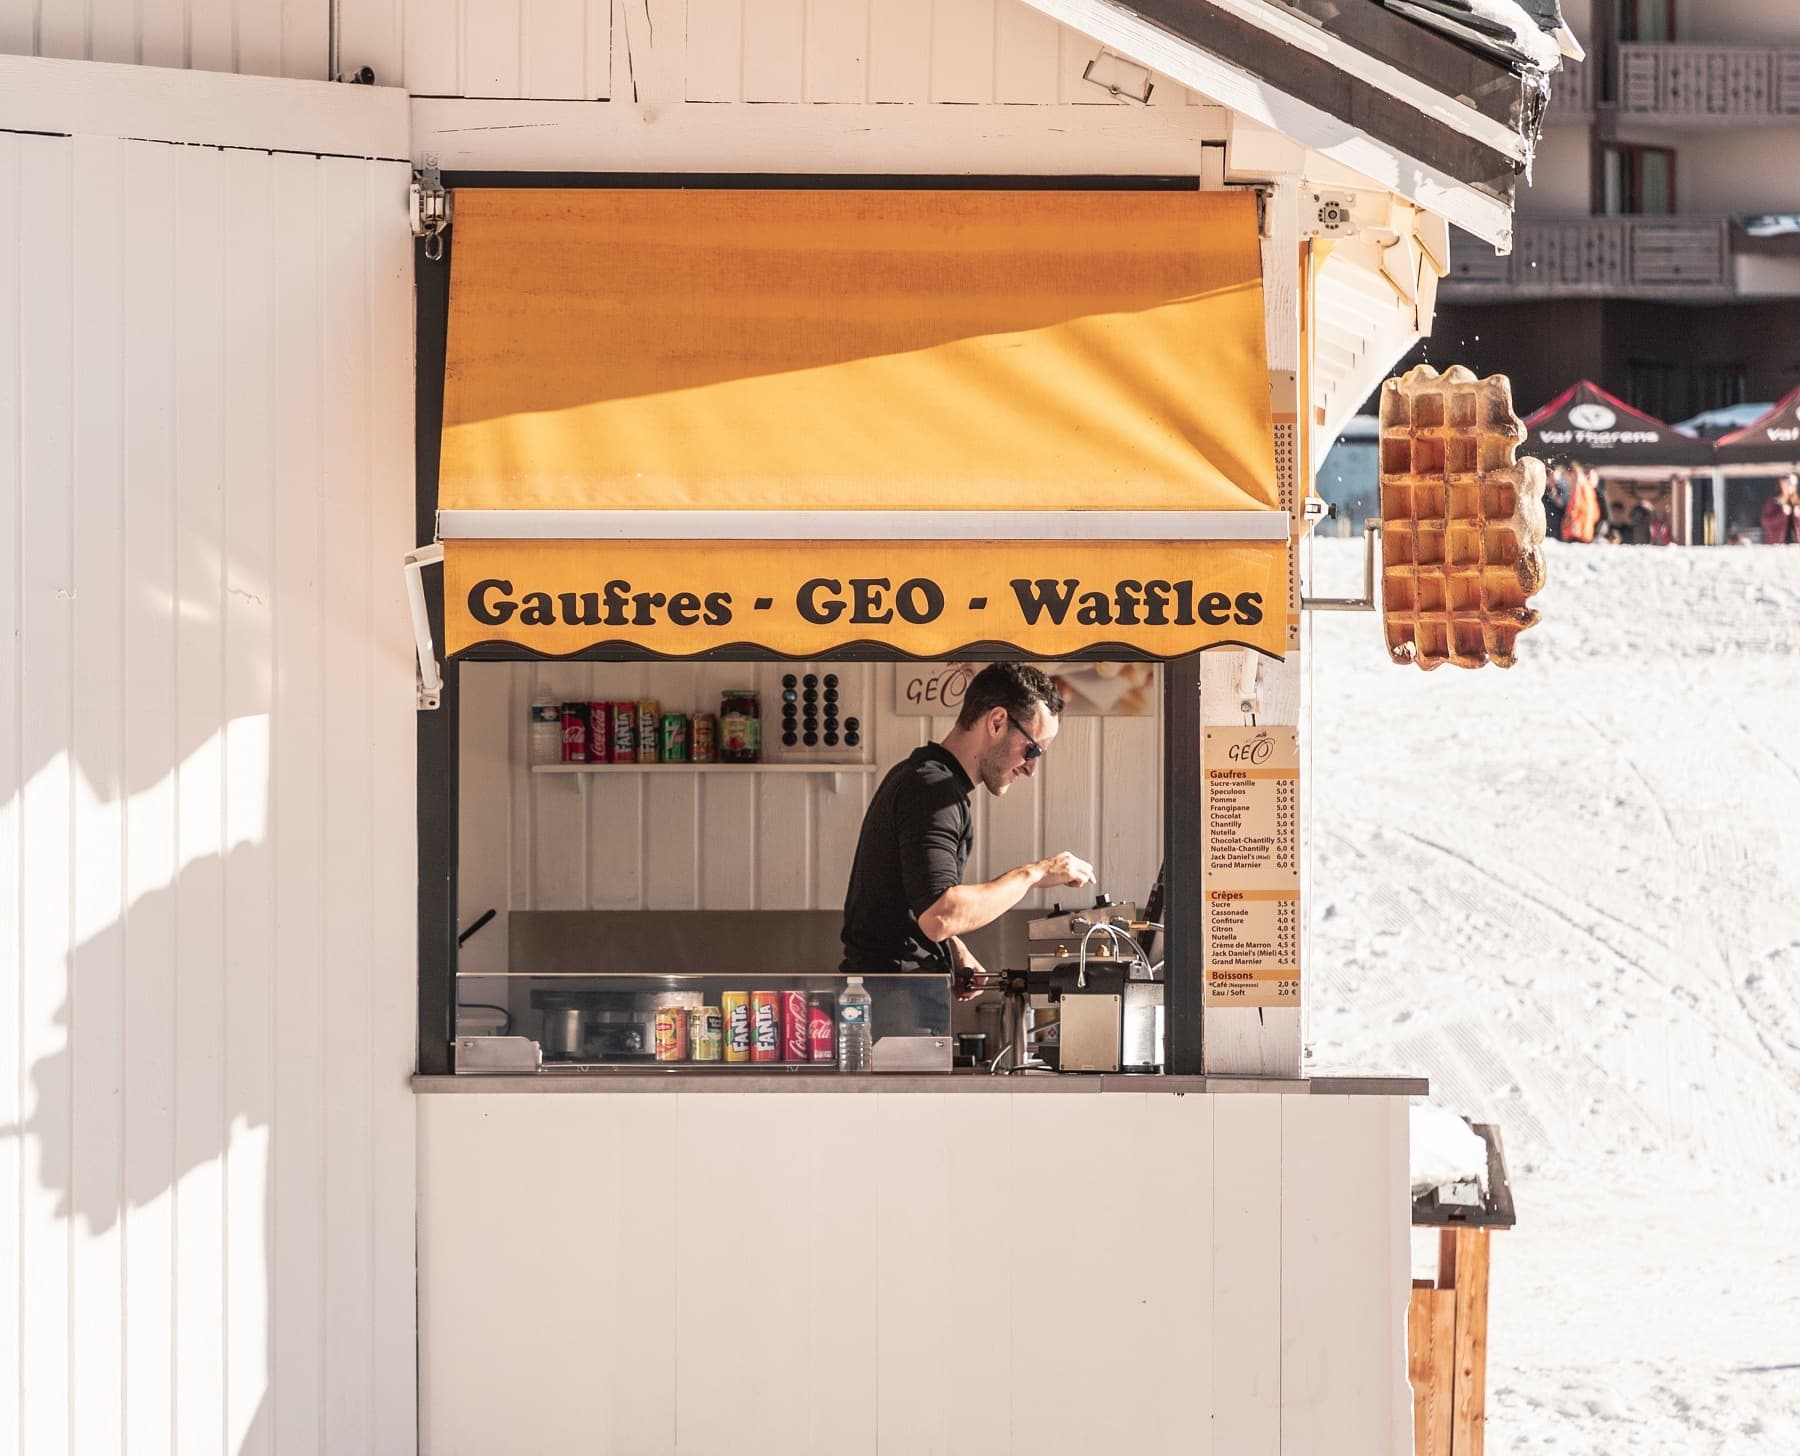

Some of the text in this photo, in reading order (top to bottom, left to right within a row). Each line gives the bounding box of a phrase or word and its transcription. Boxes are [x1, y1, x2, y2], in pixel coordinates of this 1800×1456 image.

[467, 578, 1263, 626] Gaufres - GEO - Waffles
[615, 712, 633, 752] FANTA
[1210, 770, 1247, 778] Gaufres
[1211, 891, 1243, 900] Crêpes
[732, 1004, 749, 1052] FANTA
[756, 1004, 774, 1052] FANTA
